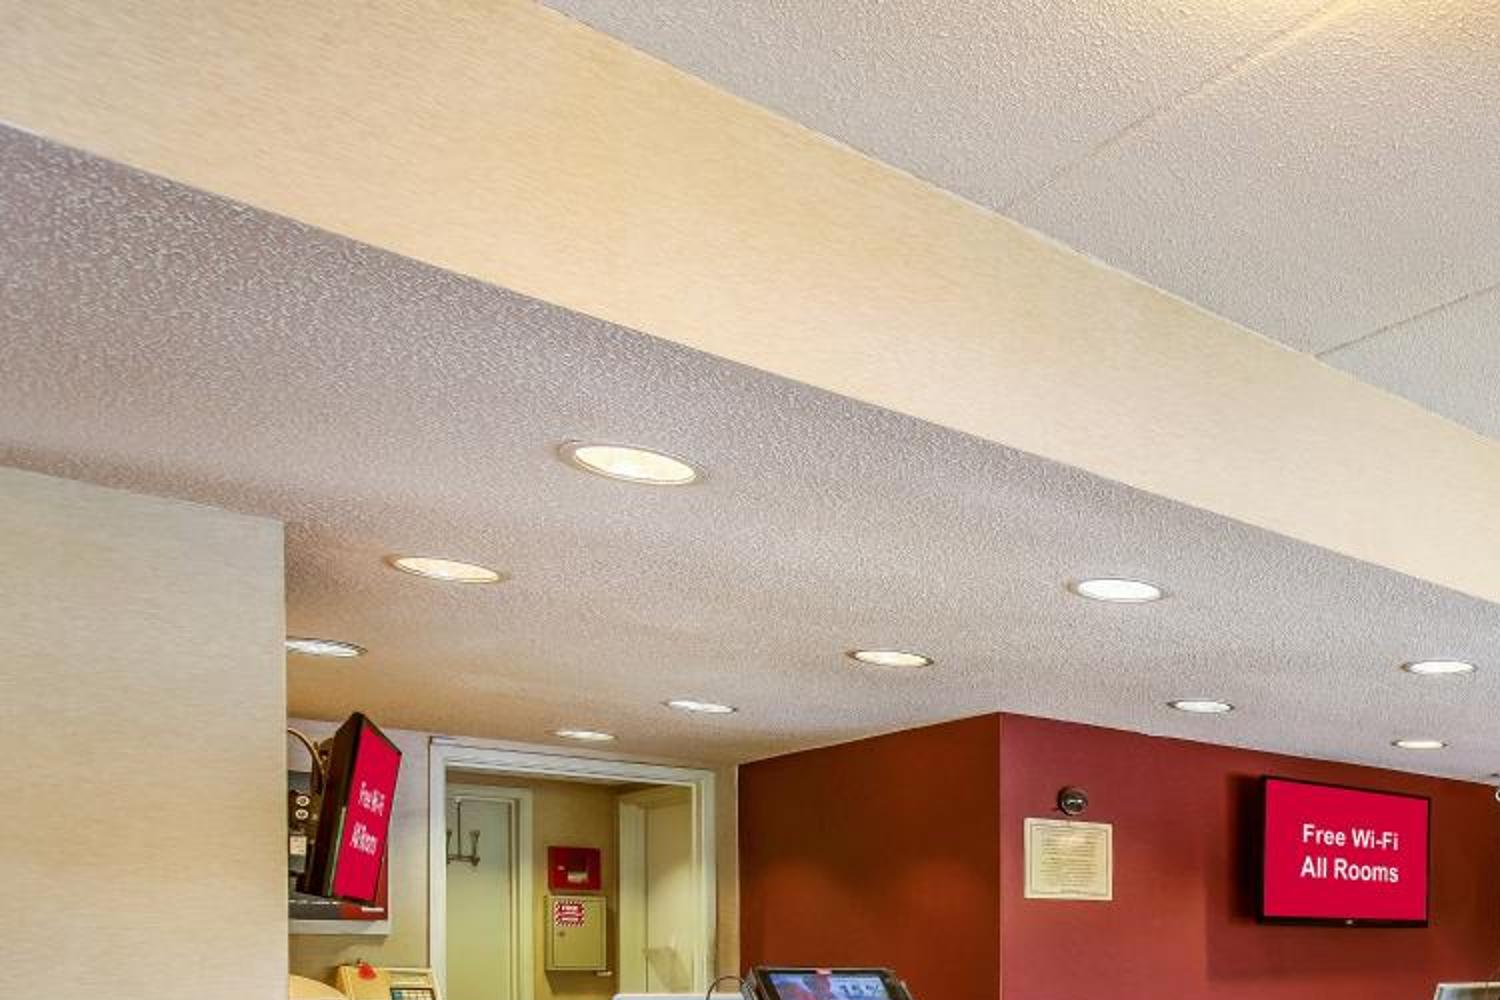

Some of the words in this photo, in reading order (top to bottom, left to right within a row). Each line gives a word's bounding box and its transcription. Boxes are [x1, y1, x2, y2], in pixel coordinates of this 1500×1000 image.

[1302, 822, 1346, 848] Free
[1351, 827, 1400, 852] Wi-Fi
[1300, 855, 1328, 879] All
[1333, 857, 1400, 884] Rooms
